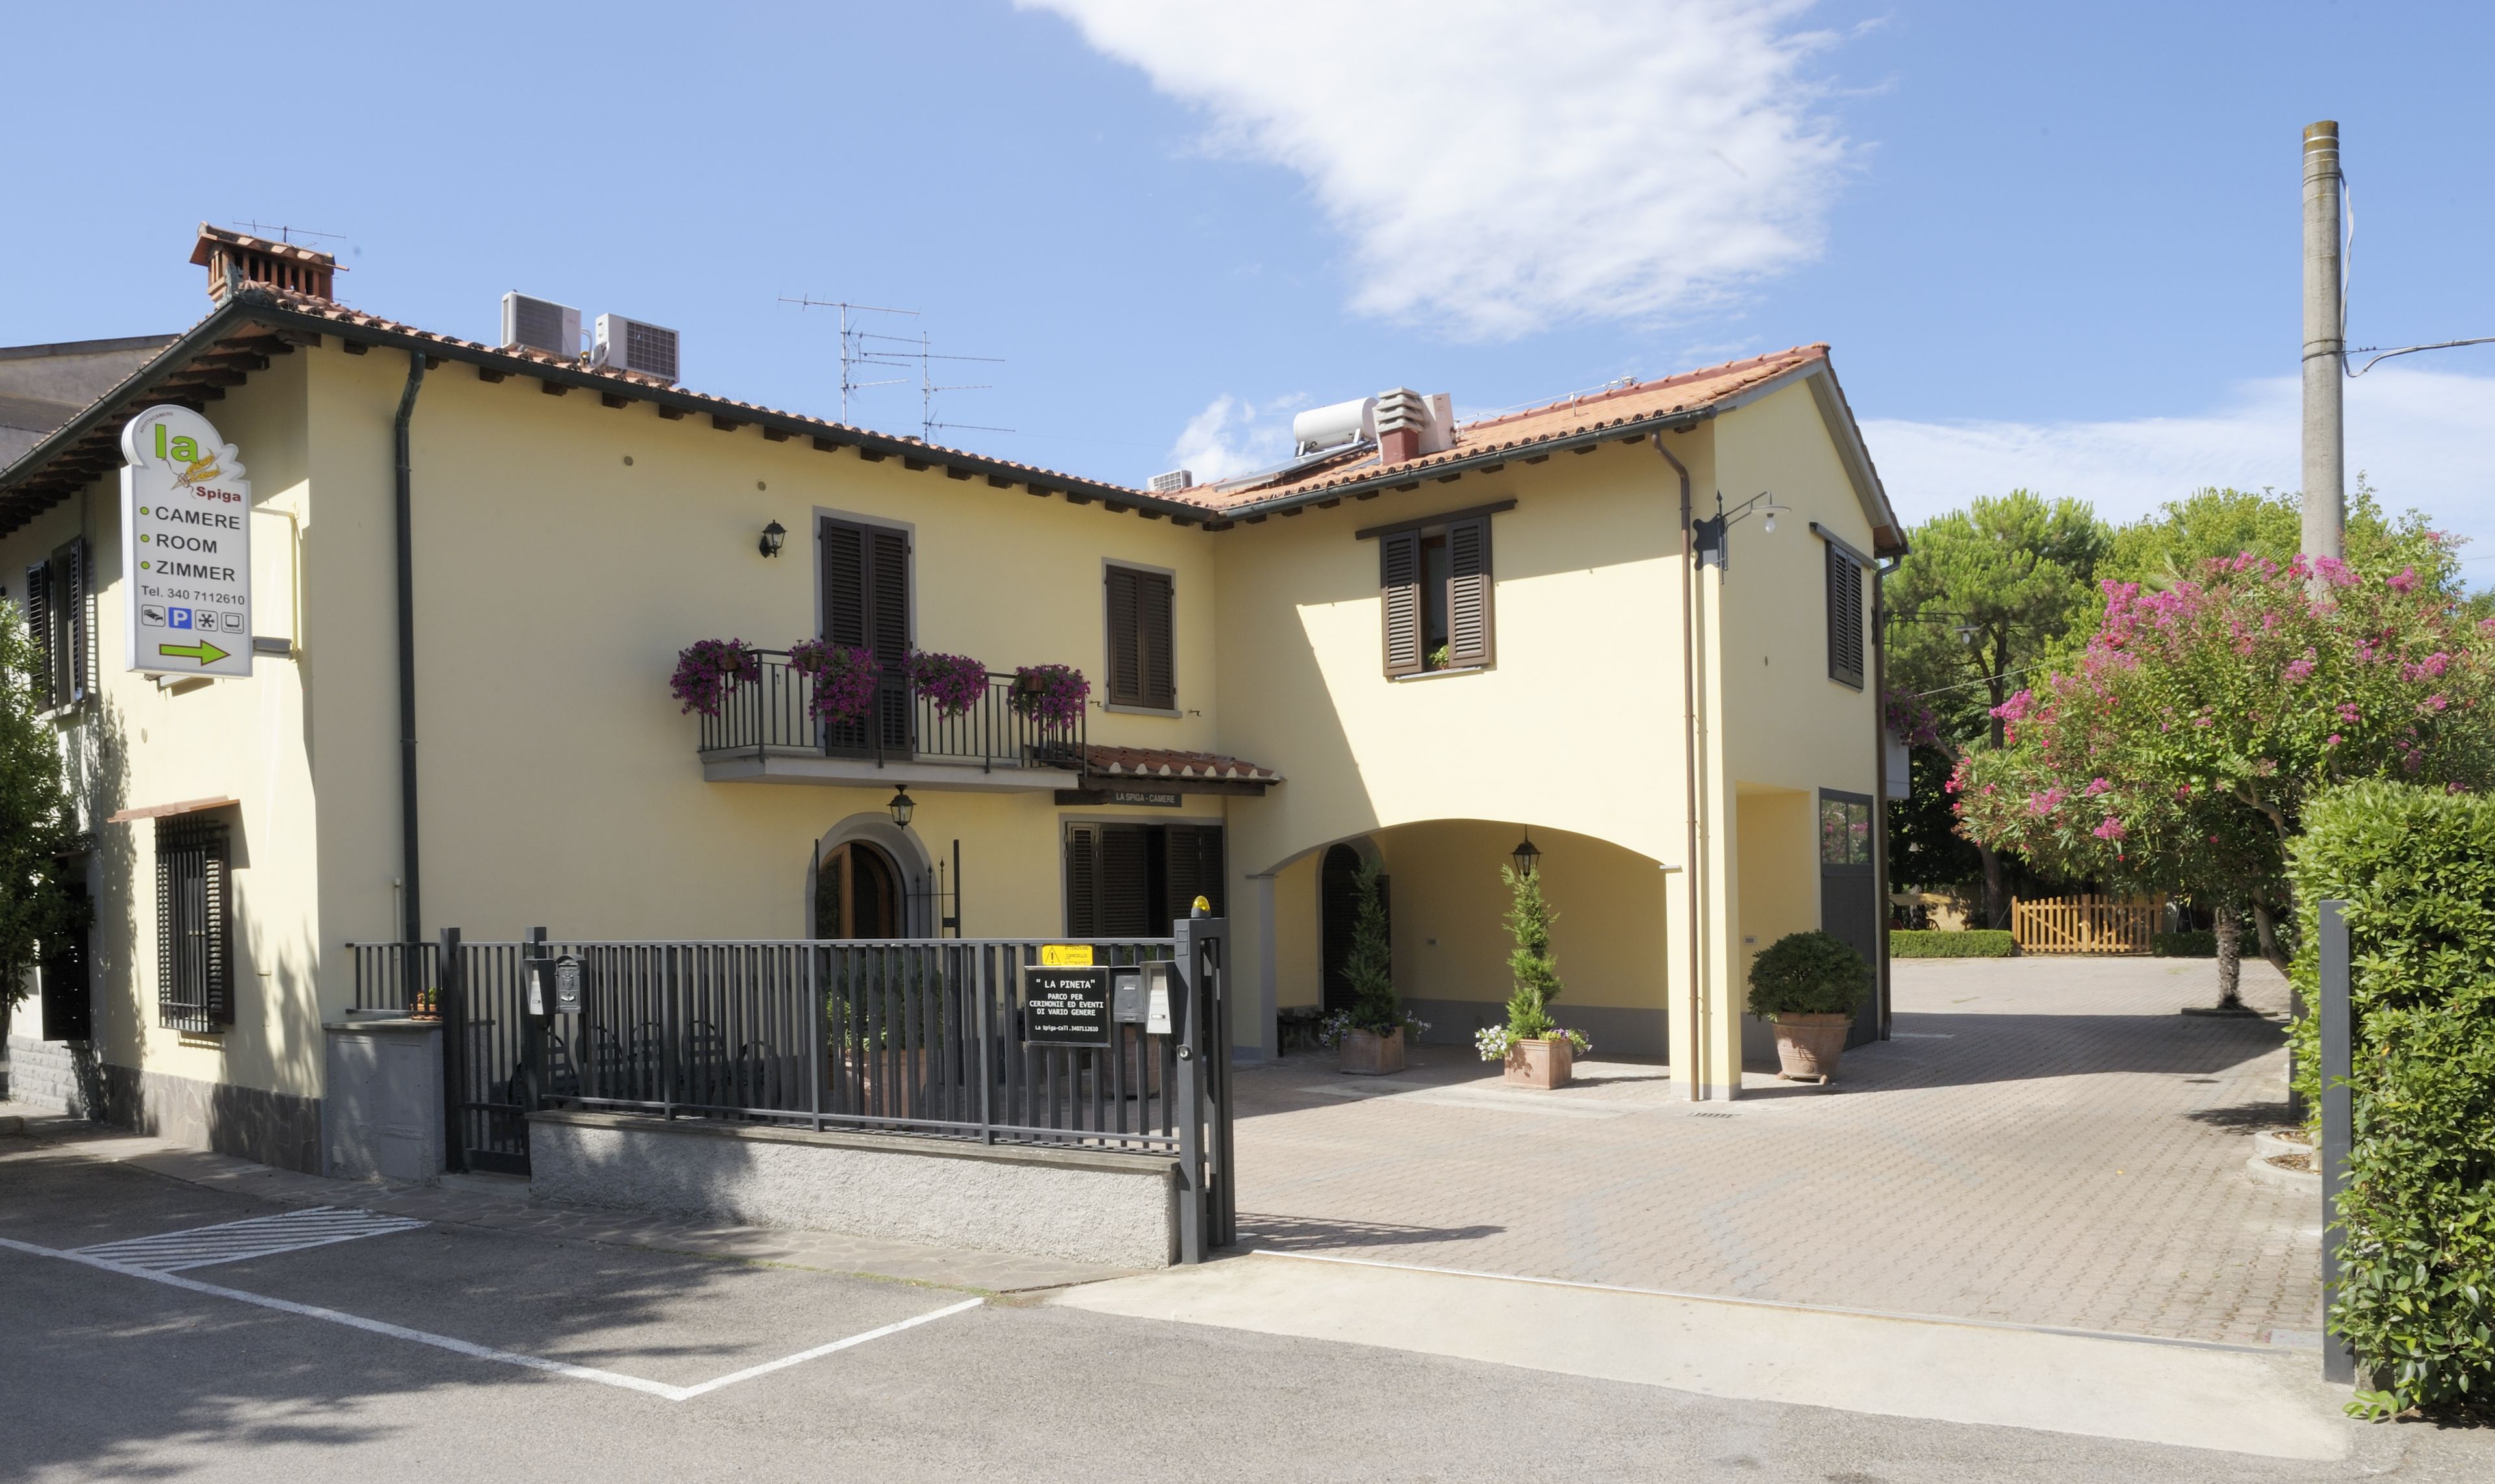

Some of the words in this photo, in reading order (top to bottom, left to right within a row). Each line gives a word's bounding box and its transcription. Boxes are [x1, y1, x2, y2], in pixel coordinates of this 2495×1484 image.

[155, 424, 199, 463] la
[196, 486, 242, 503] Spiga
[155, 506, 240, 530] CAMERE
[156, 533, 217, 554] ROOM
[156, 560, 235, 582] ZIMMER
[141, 585, 163, 597] Tel.
[167, 588, 190, 600] 340
[194, 591, 245, 605] 7112610
[1116, 792, 1125, 800] LA
[1125, 793, 1144, 802] SPIGA
[1149, 794, 1175, 803] CAMERE
[1060, 979, 1095, 989] PINETA"
